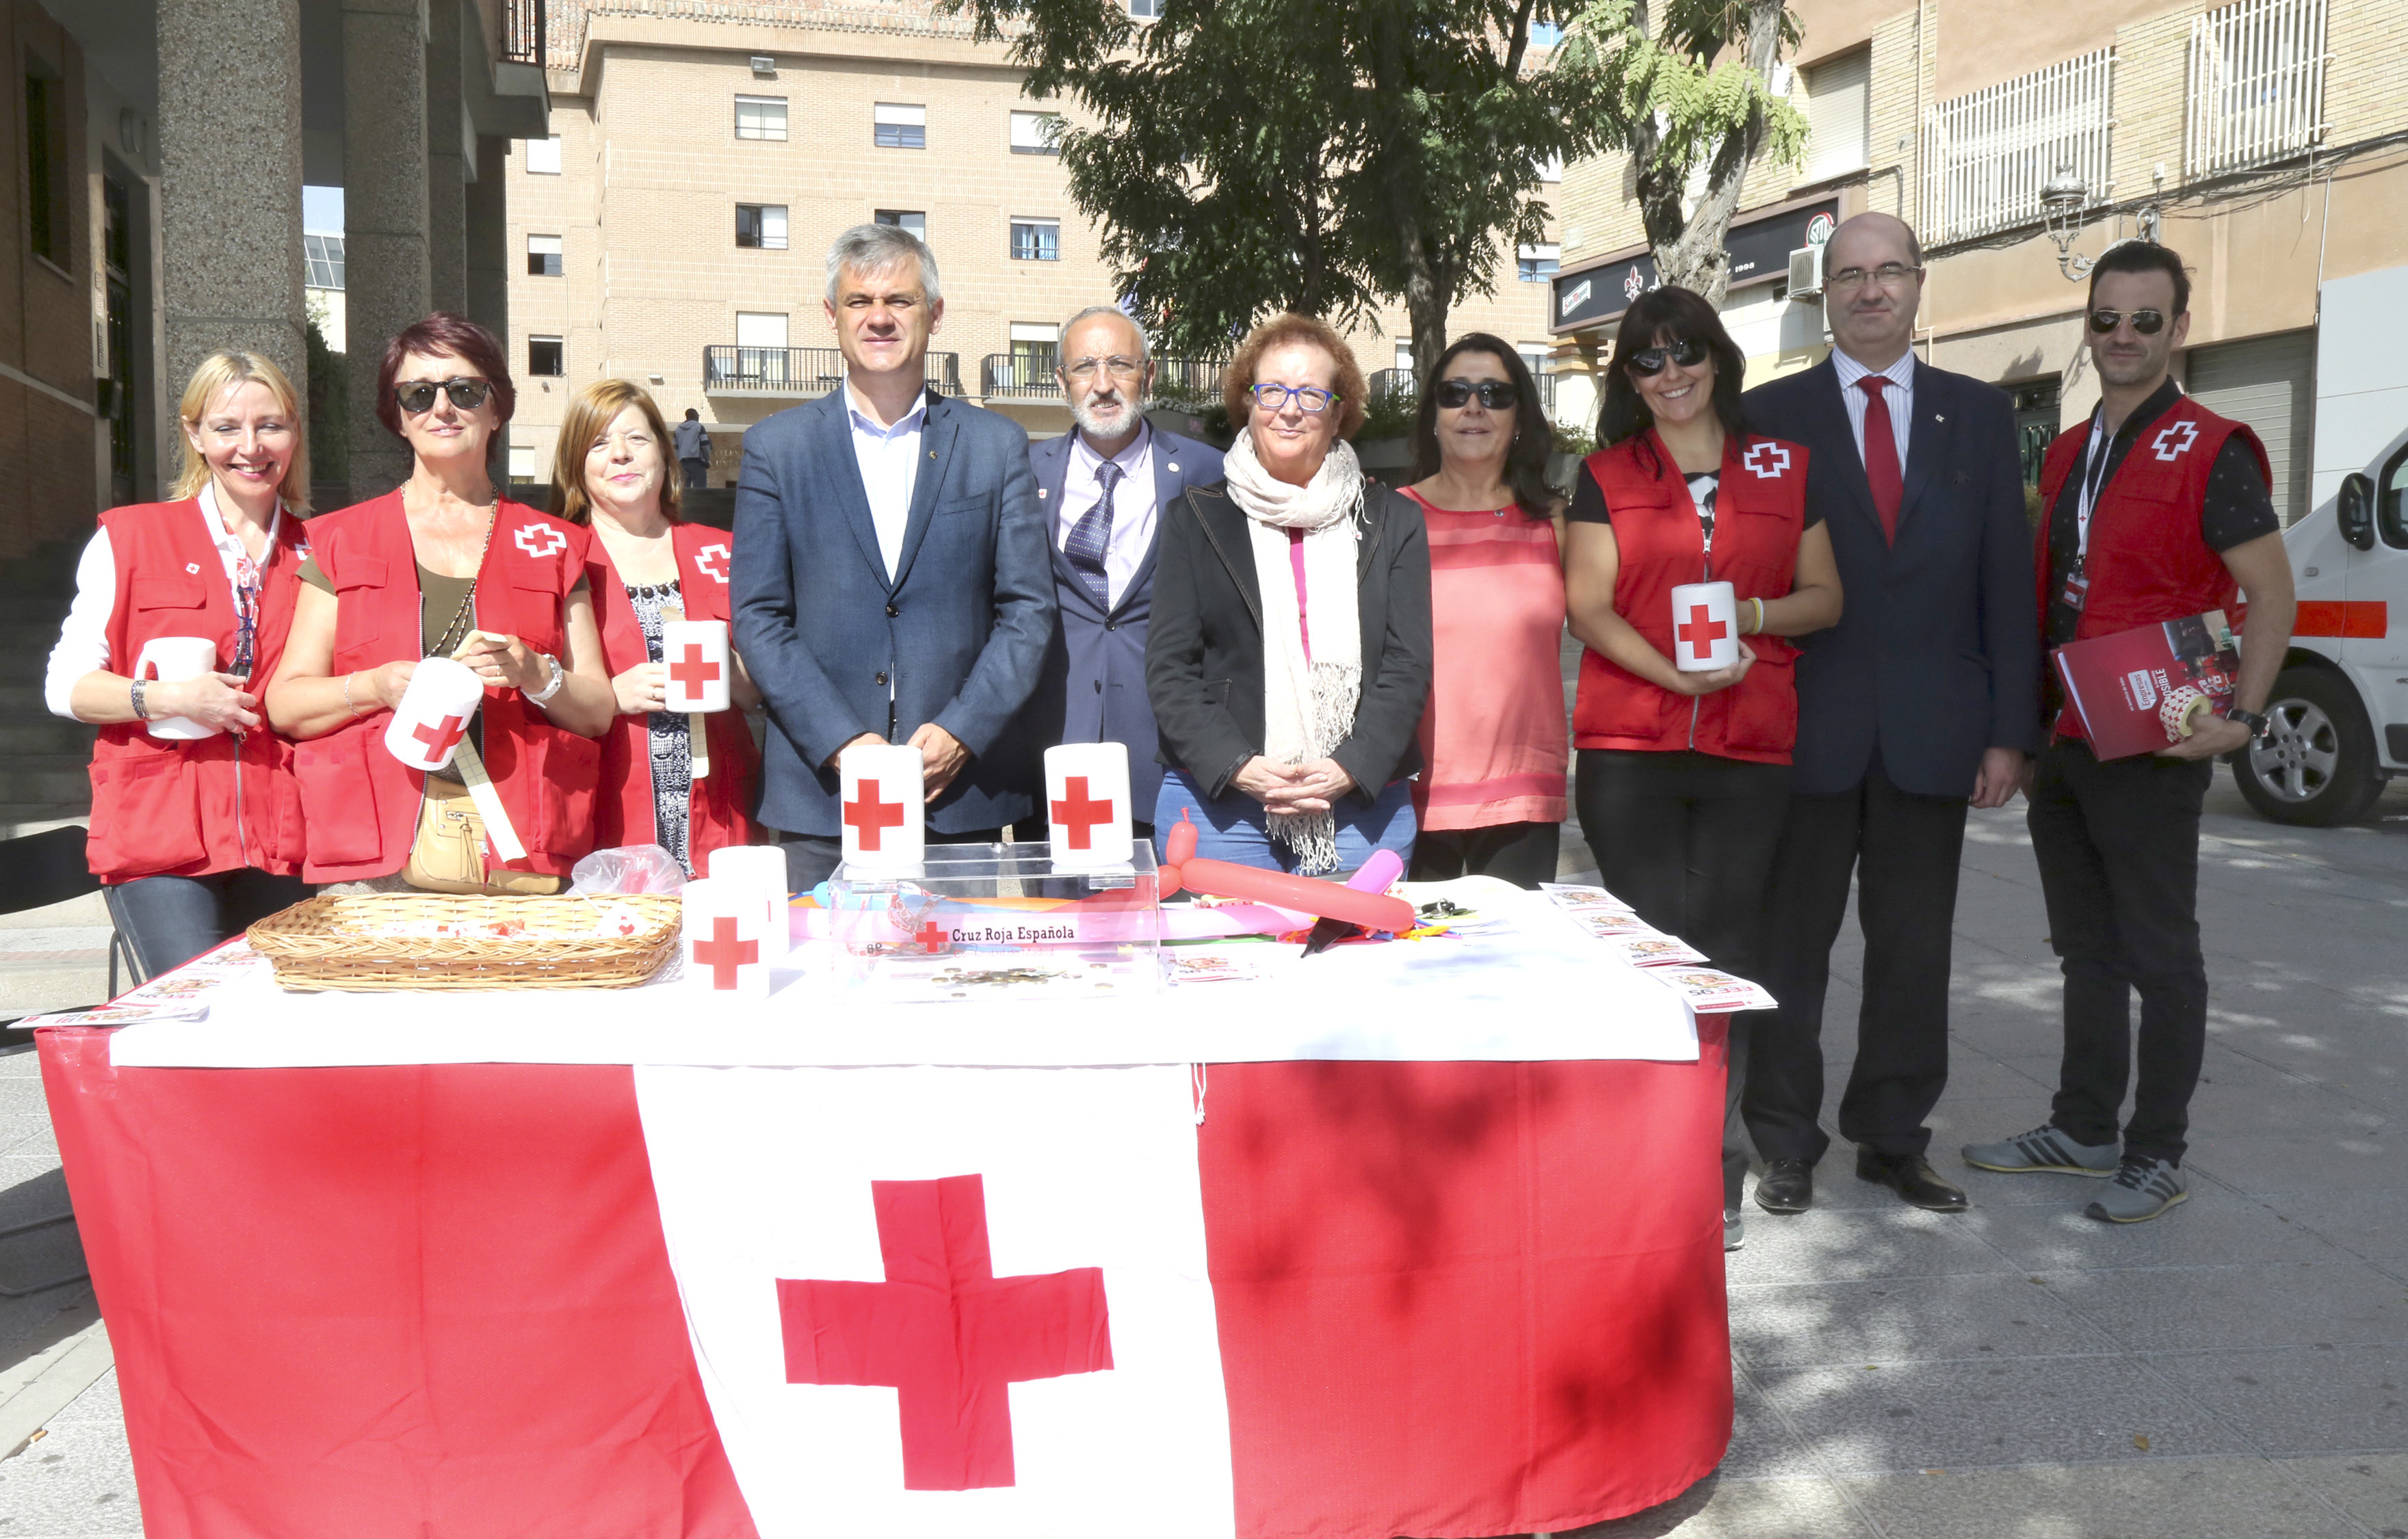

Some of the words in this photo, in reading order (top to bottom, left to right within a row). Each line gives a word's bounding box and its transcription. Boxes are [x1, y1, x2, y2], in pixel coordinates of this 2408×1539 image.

[1735, 262, 1755, 273] 1998
[2135, 674, 2150, 706] Empresas
[2155, 668, 2173, 699] OSIBLE
[952, 929, 982, 942] Cruz
[985, 928, 1012, 945] Roja
[1017, 925, 1075, 943] Española
